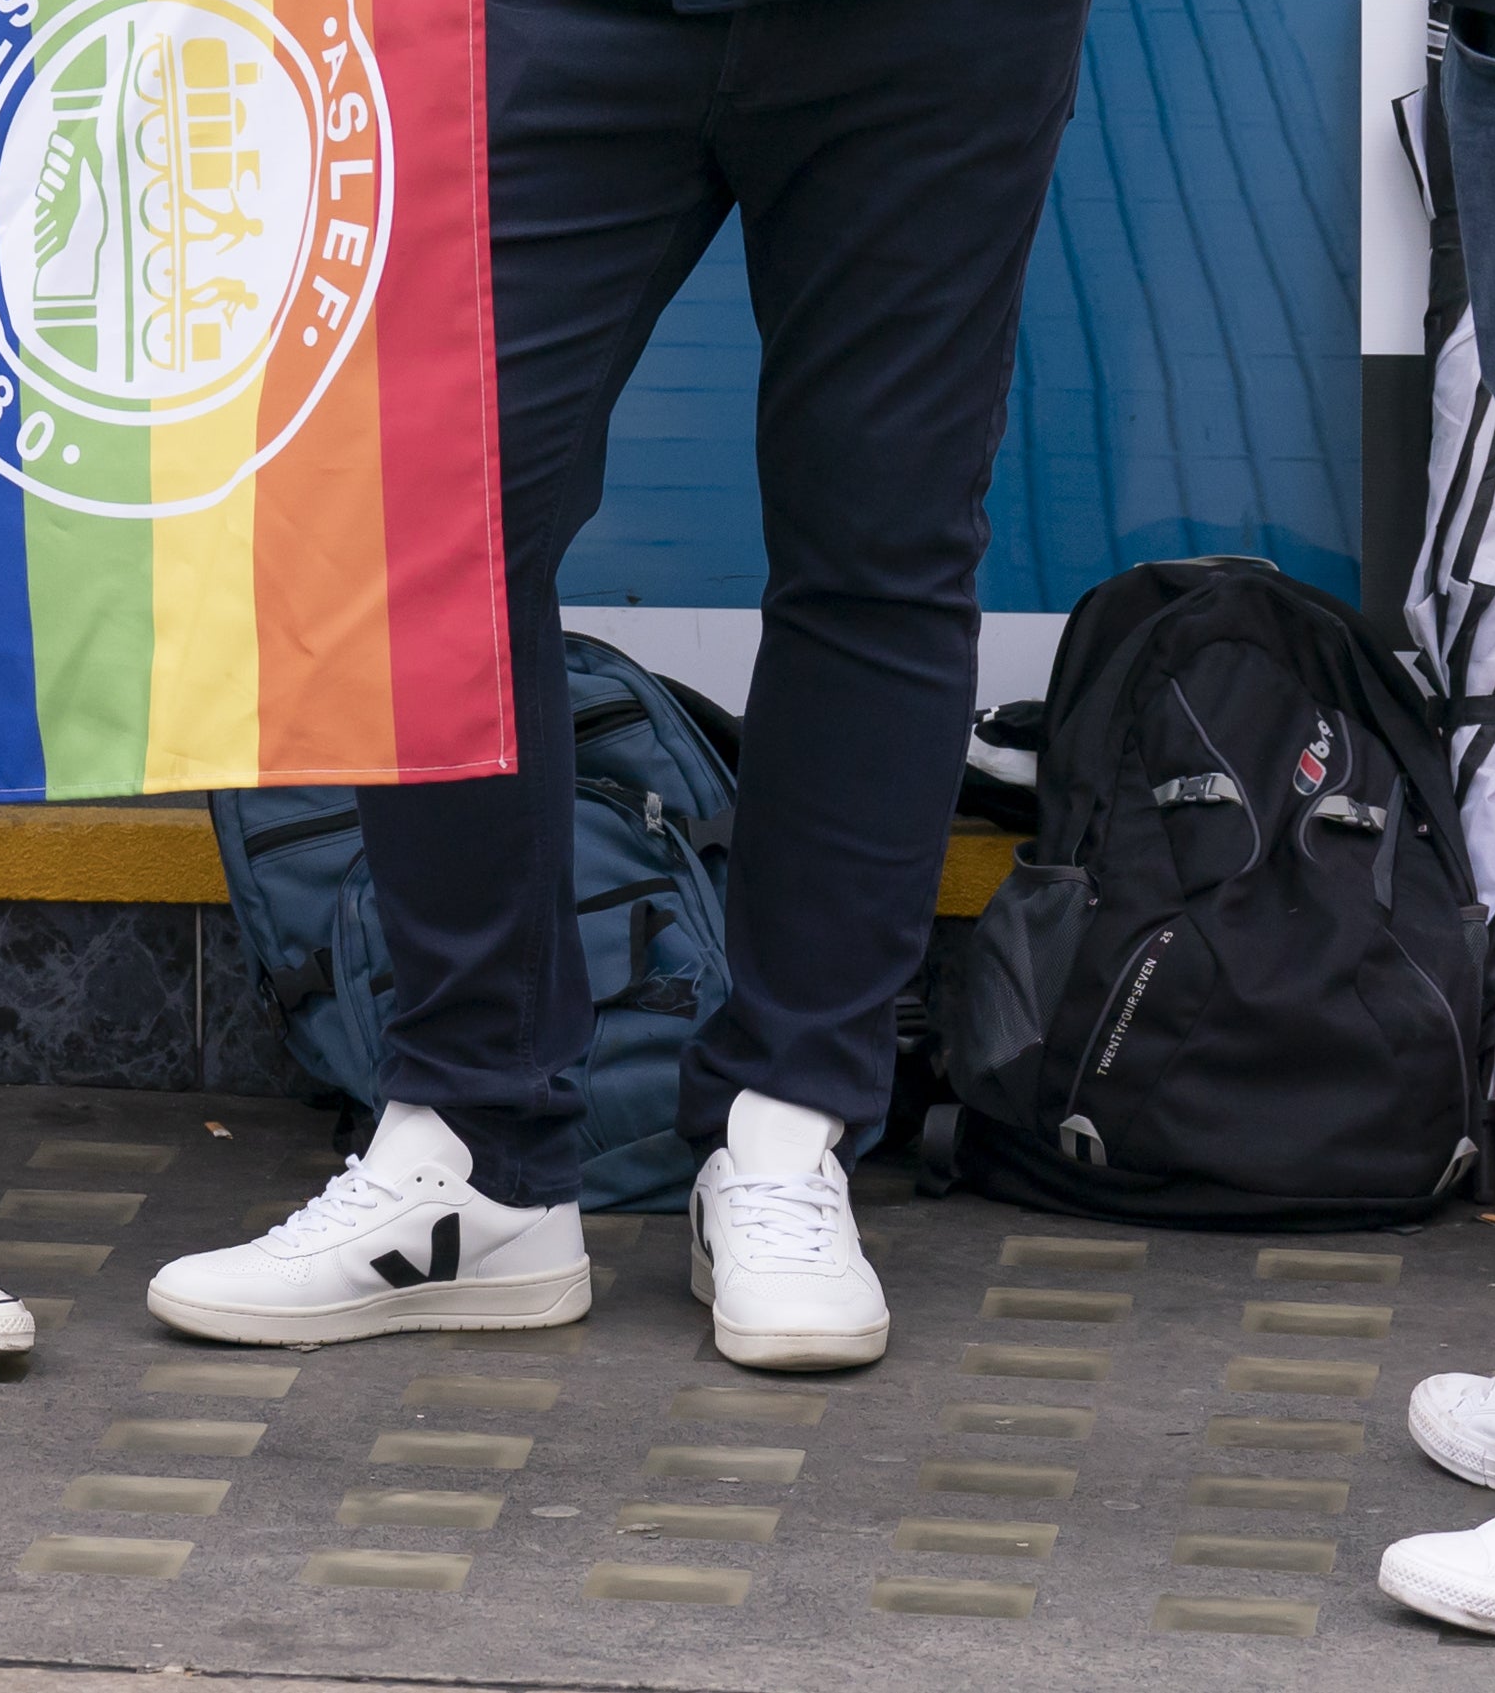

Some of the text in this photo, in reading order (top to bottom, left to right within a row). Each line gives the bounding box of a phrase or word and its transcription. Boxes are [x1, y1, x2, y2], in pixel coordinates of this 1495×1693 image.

[316, 48, 374, 333] ASLEF
[1097, 931, 1174, 1076] TWENTYFOURSEVEN 25
